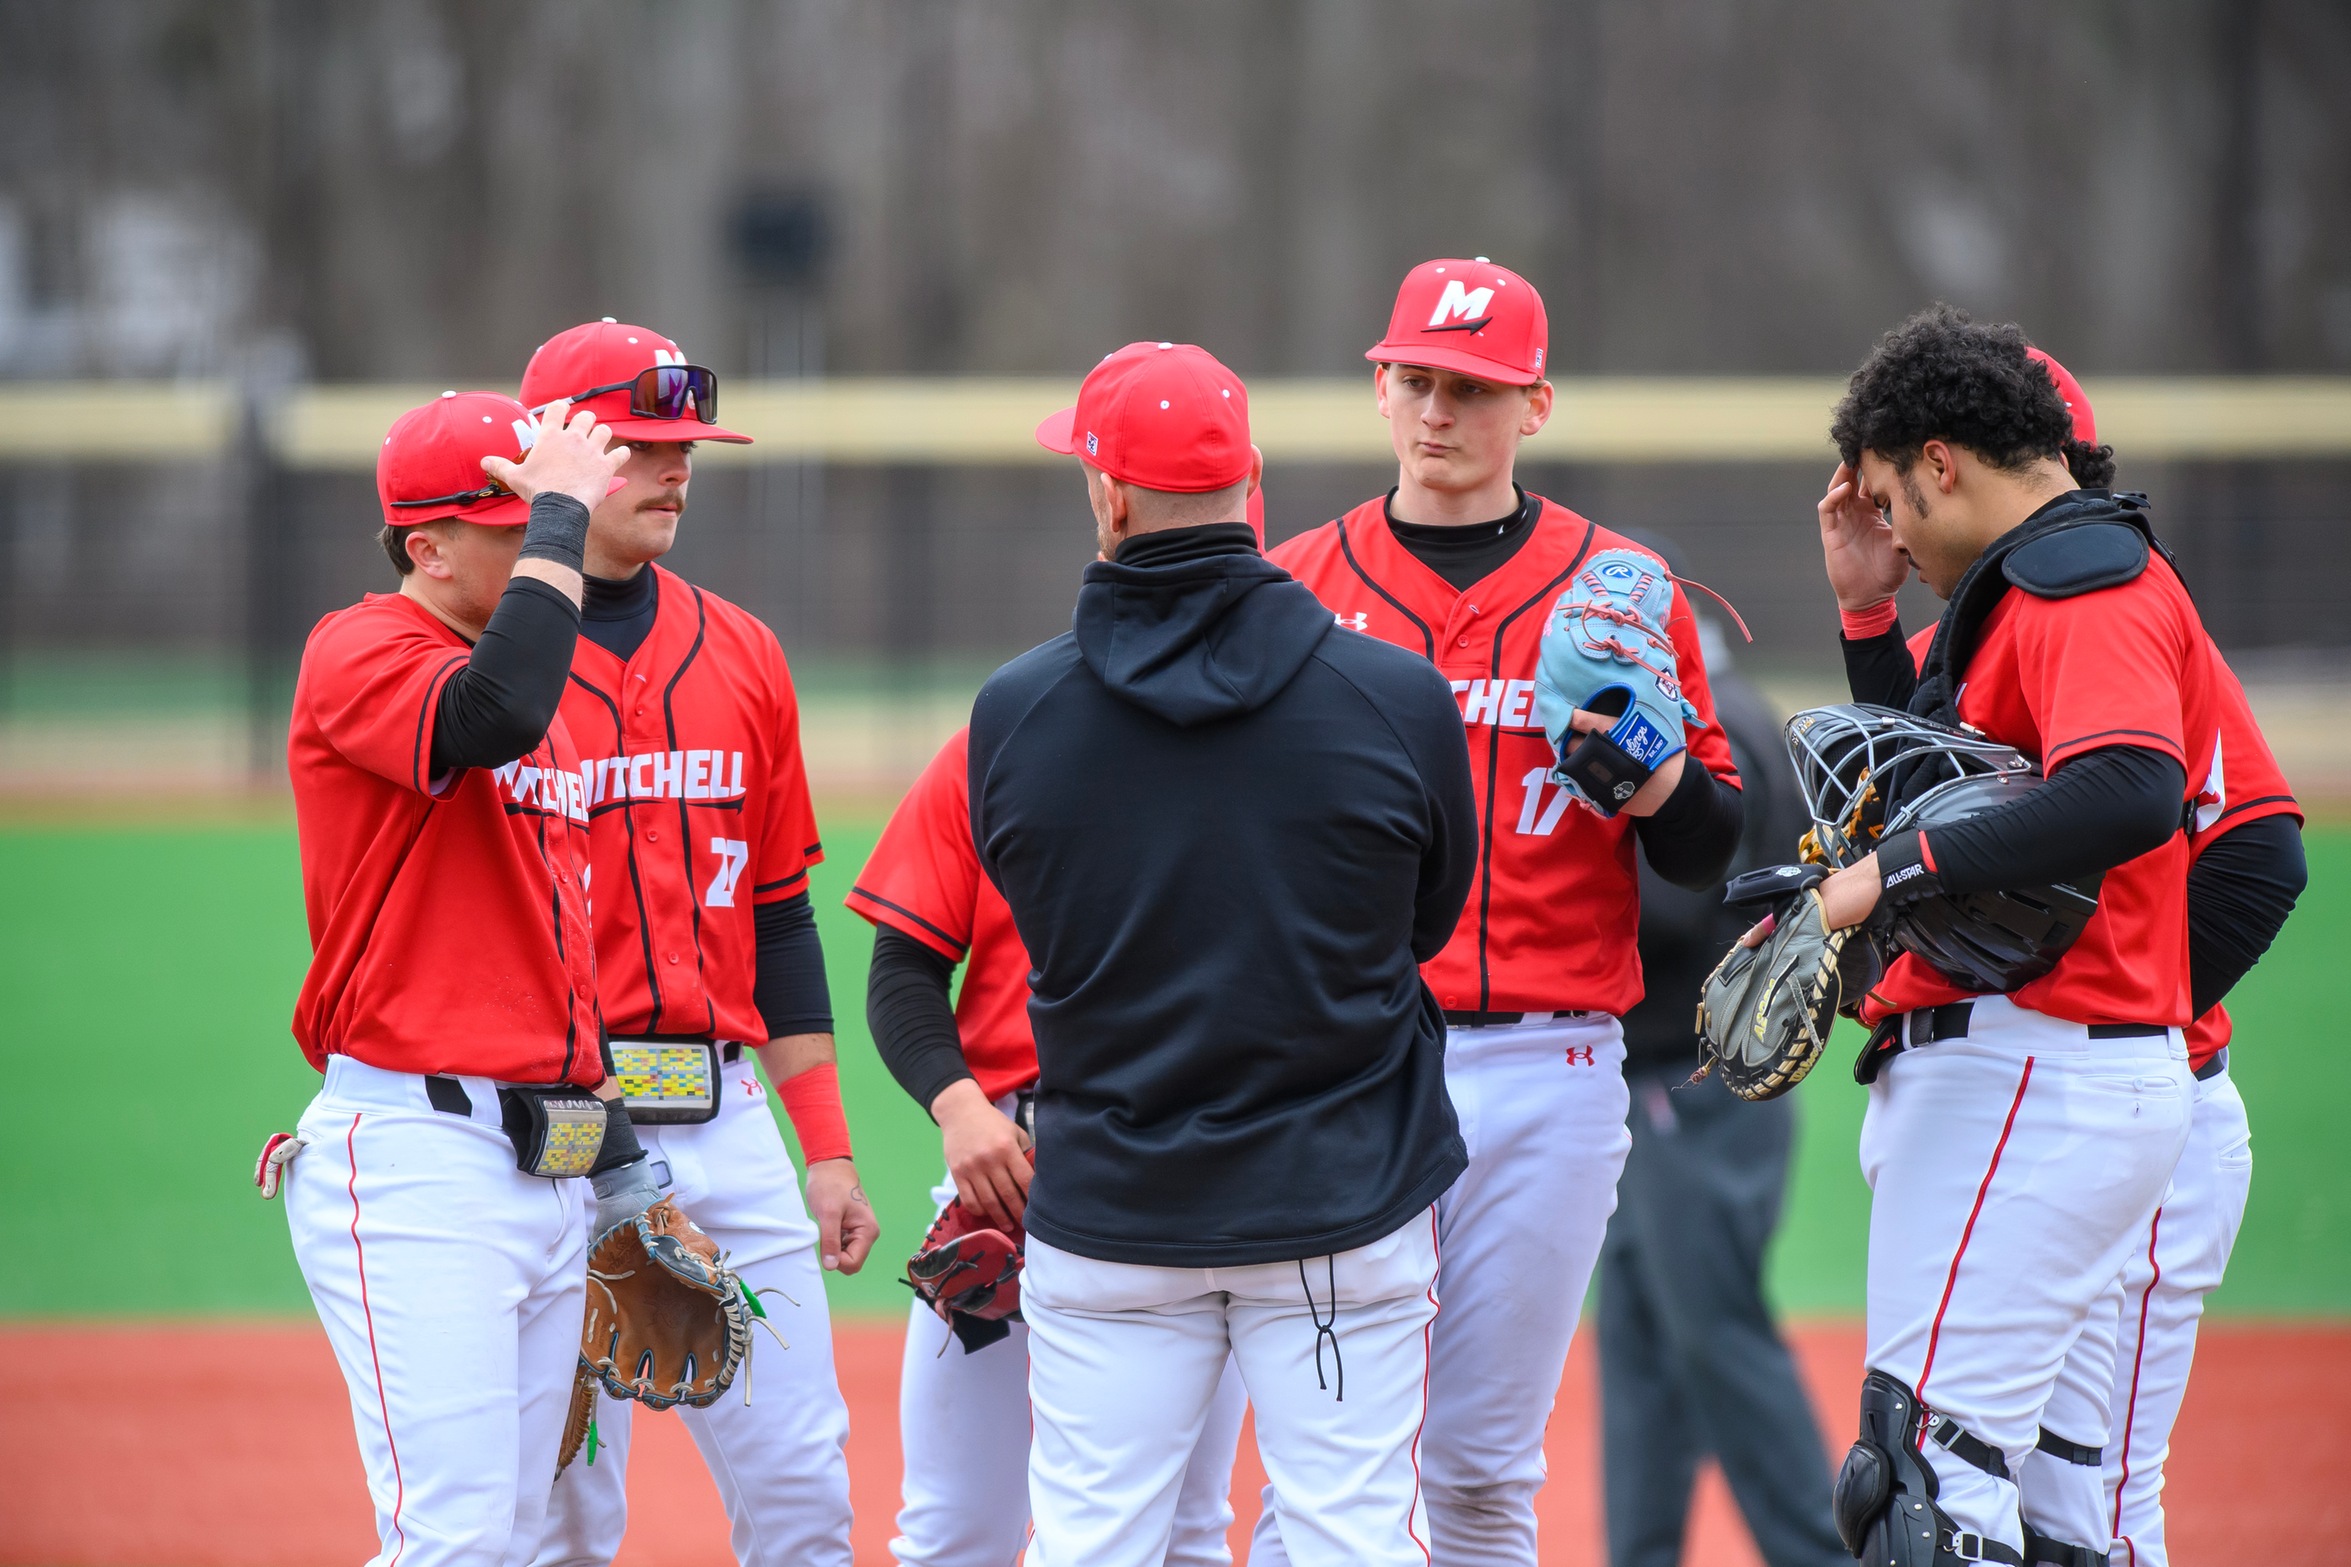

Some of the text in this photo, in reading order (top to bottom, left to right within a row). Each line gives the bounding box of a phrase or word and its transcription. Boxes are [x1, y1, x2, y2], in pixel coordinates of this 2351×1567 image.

[1428, 280, 1495, 326] M
[1516, 767, 1573, 836] 17
[705, 837, 748, 907] 27
